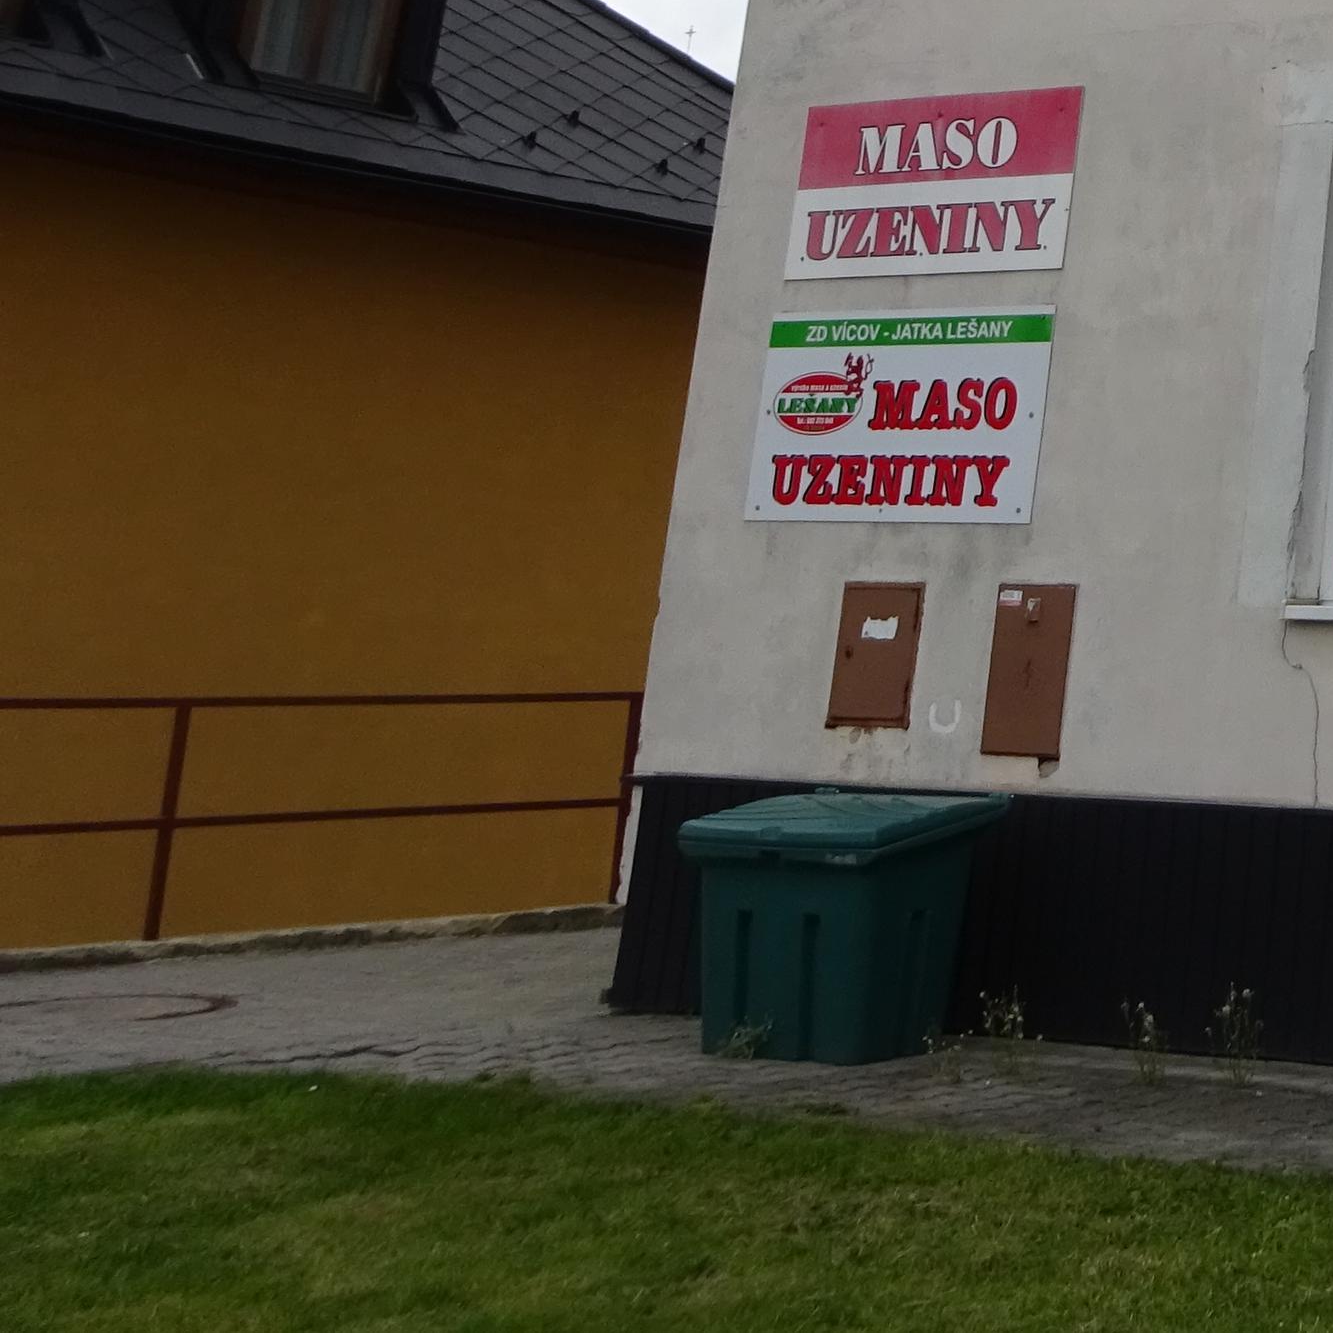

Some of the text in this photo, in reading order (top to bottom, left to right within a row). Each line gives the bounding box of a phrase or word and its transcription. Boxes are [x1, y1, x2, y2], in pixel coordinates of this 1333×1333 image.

[855, 117, 1018, 176] MASO
[806, 198, 1055, 261] UZENINY
[806, 325, 827, 342] ZD
[832, 322, 880, 341] VÍCOV
[891, 323, 943, 340] JATKA
[947, 318, 1013, 339] LEŠANY
[867, 377, 1018, 431] MASO
[771, 454, 1011, 507] UZENINY
